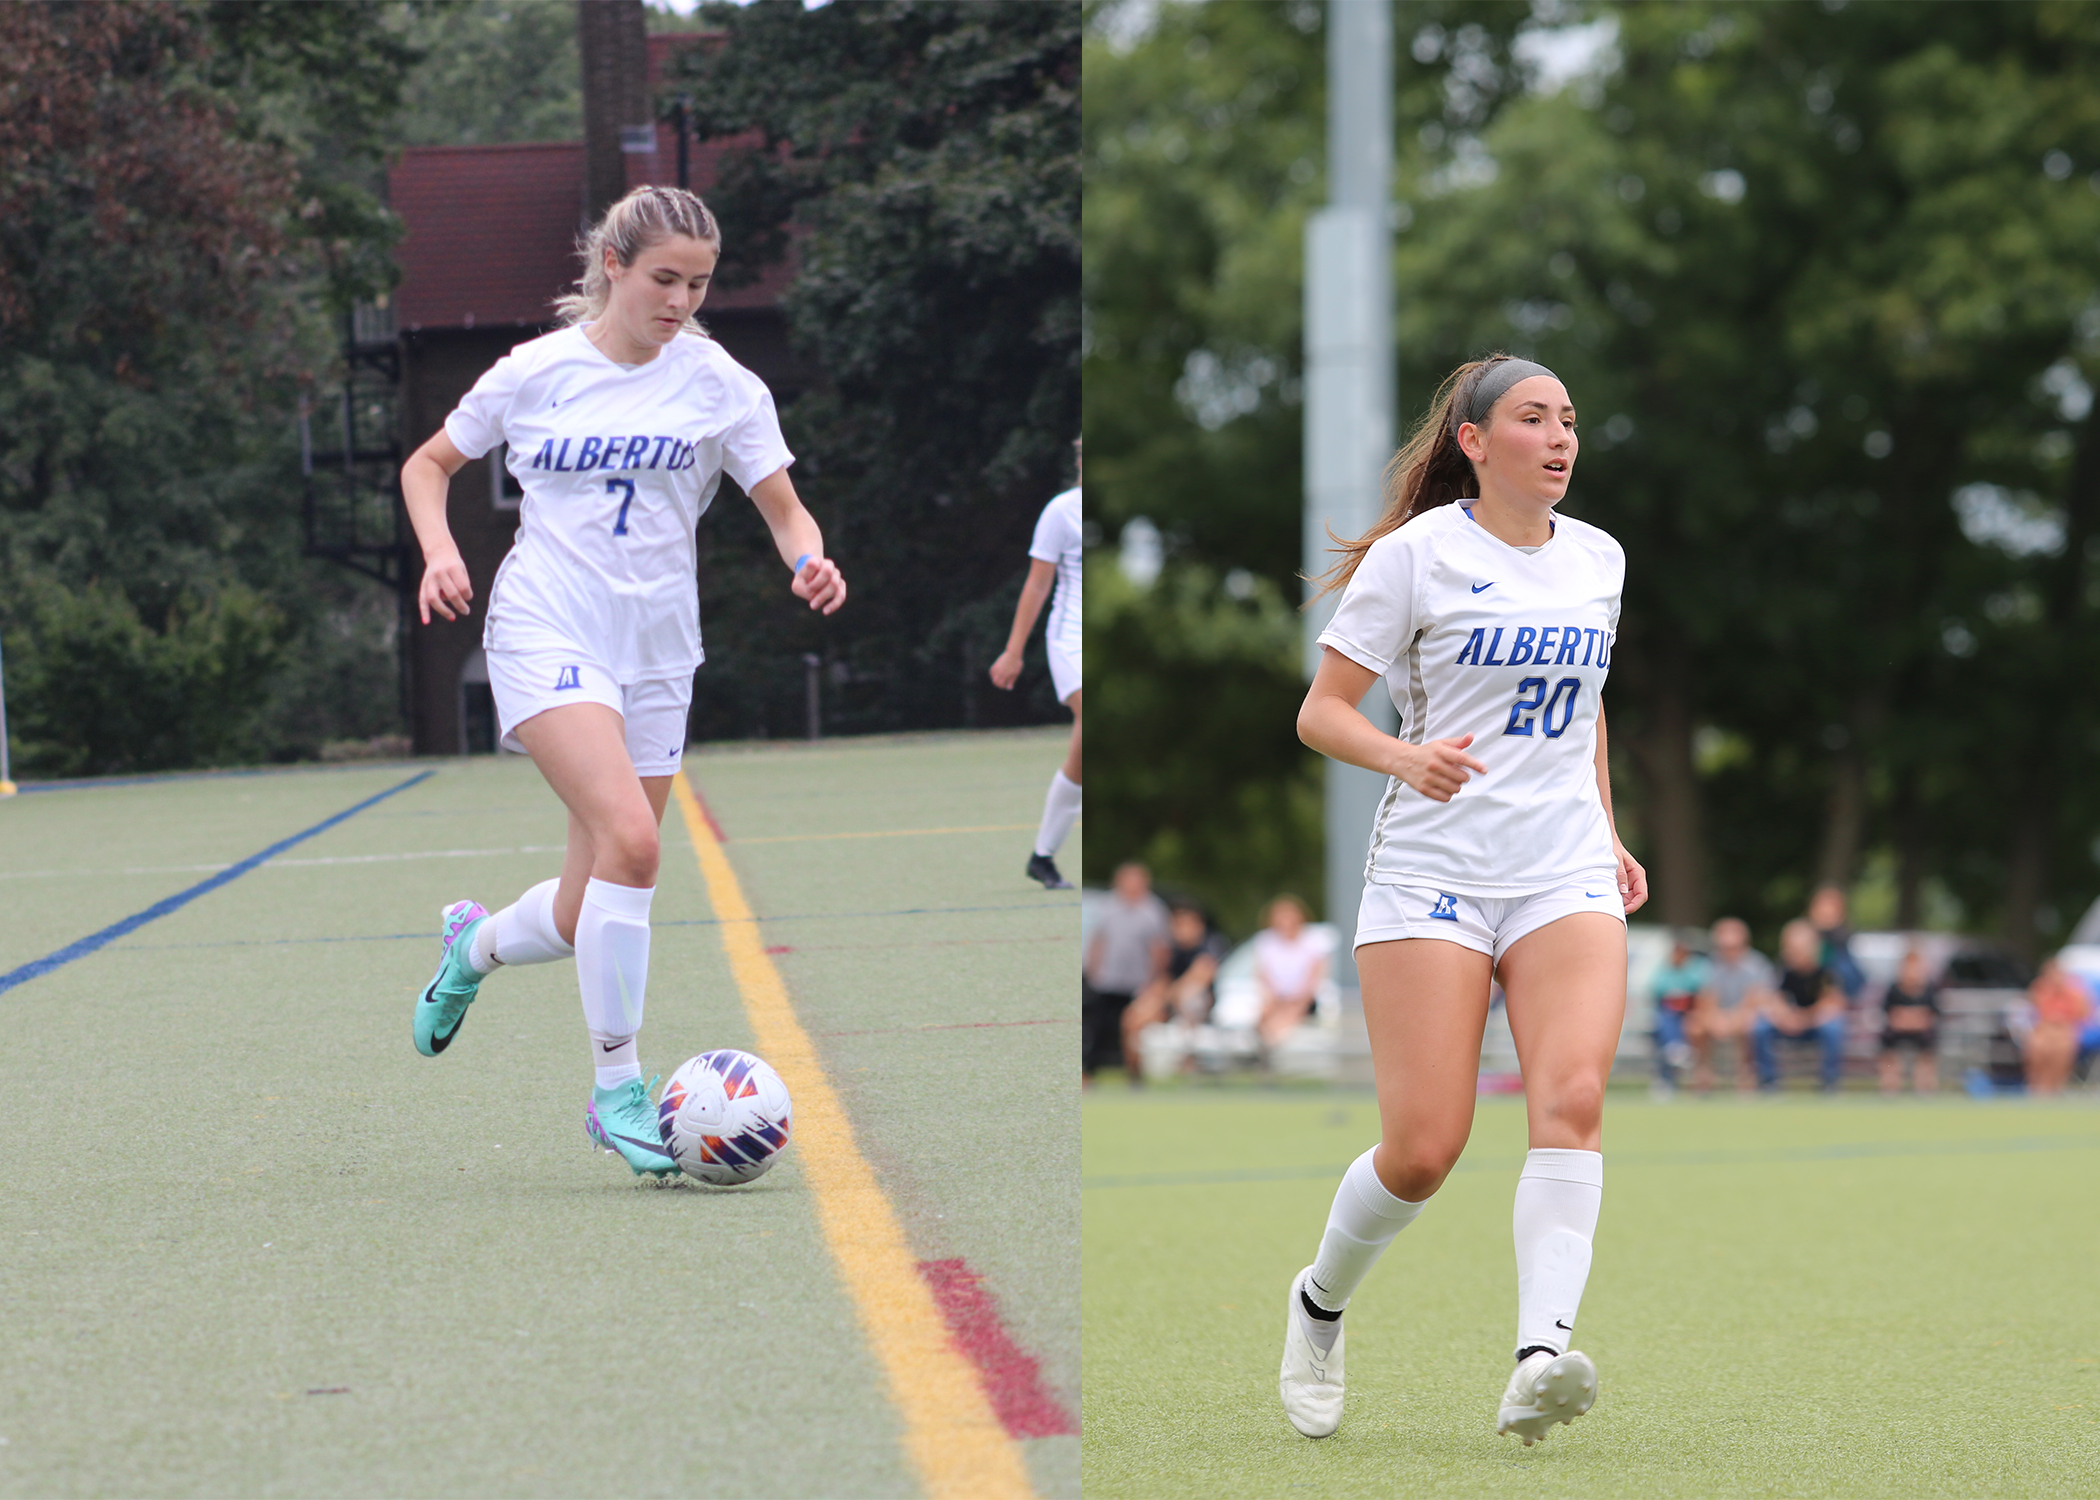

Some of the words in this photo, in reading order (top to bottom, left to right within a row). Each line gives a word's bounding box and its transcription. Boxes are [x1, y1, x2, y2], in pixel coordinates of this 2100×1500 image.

[606, 477, 635, 536] 7
[1454, 626, 1611, 669] ALBERTU
[1501, 675, 1582, 740] 20
